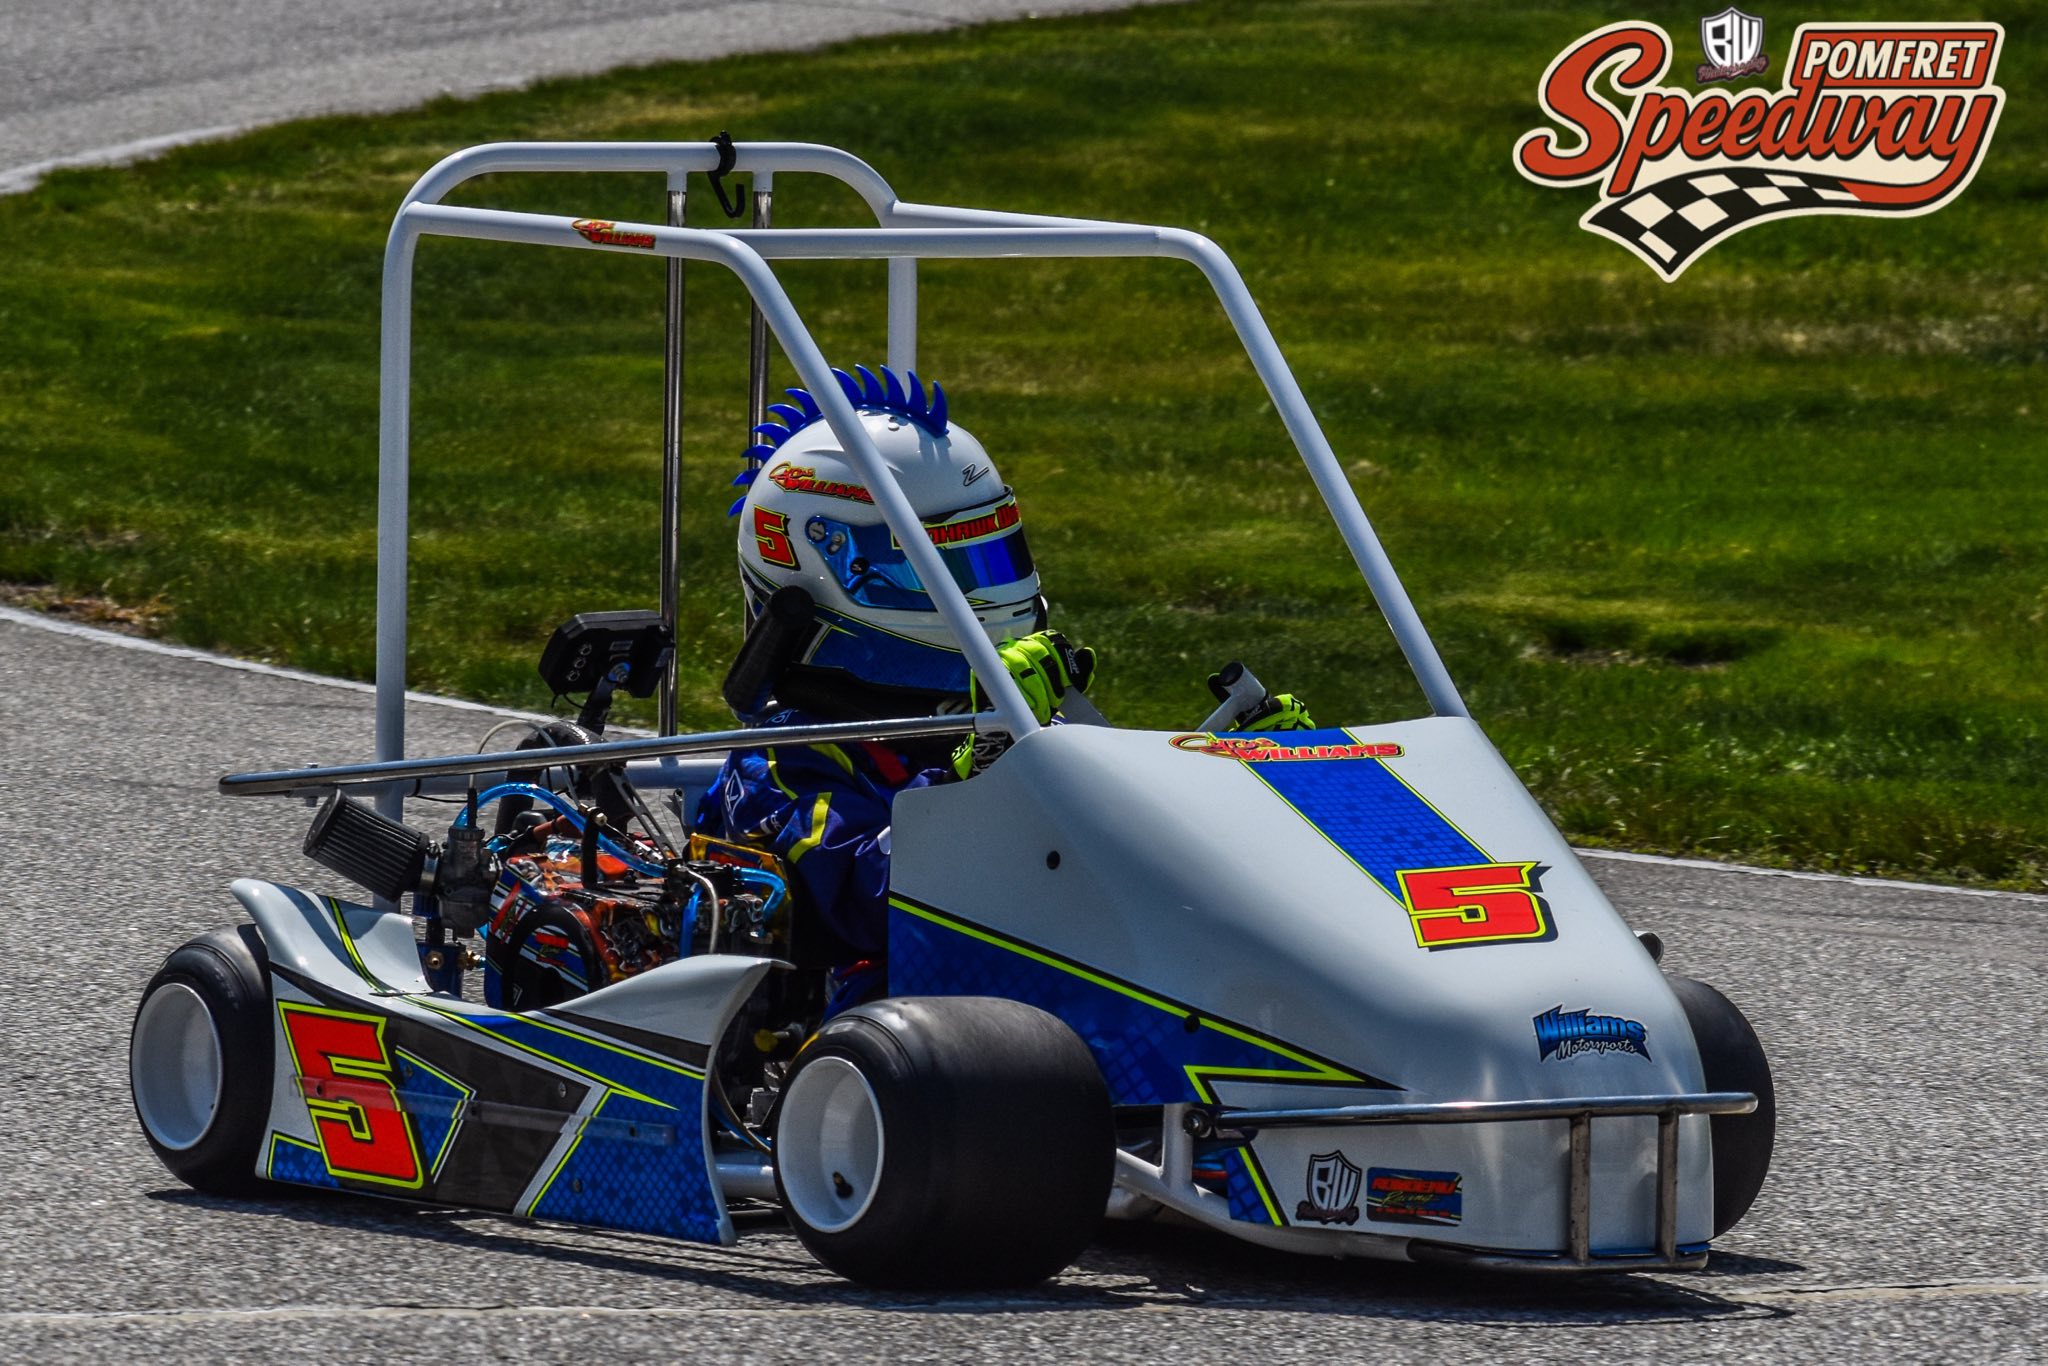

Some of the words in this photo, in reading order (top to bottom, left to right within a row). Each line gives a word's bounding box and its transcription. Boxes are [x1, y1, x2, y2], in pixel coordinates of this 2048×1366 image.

[754, 505, 799, 570] 5
[1234, 742, 1403, 761] WILLIAMS
[1396, 861, 1548, 949] 5
[1534, 1005, 1647, 1042] Williams
[1556, 1039, 1638, 1059] Motorsports
[277, 1000, 424, 1189] 5
